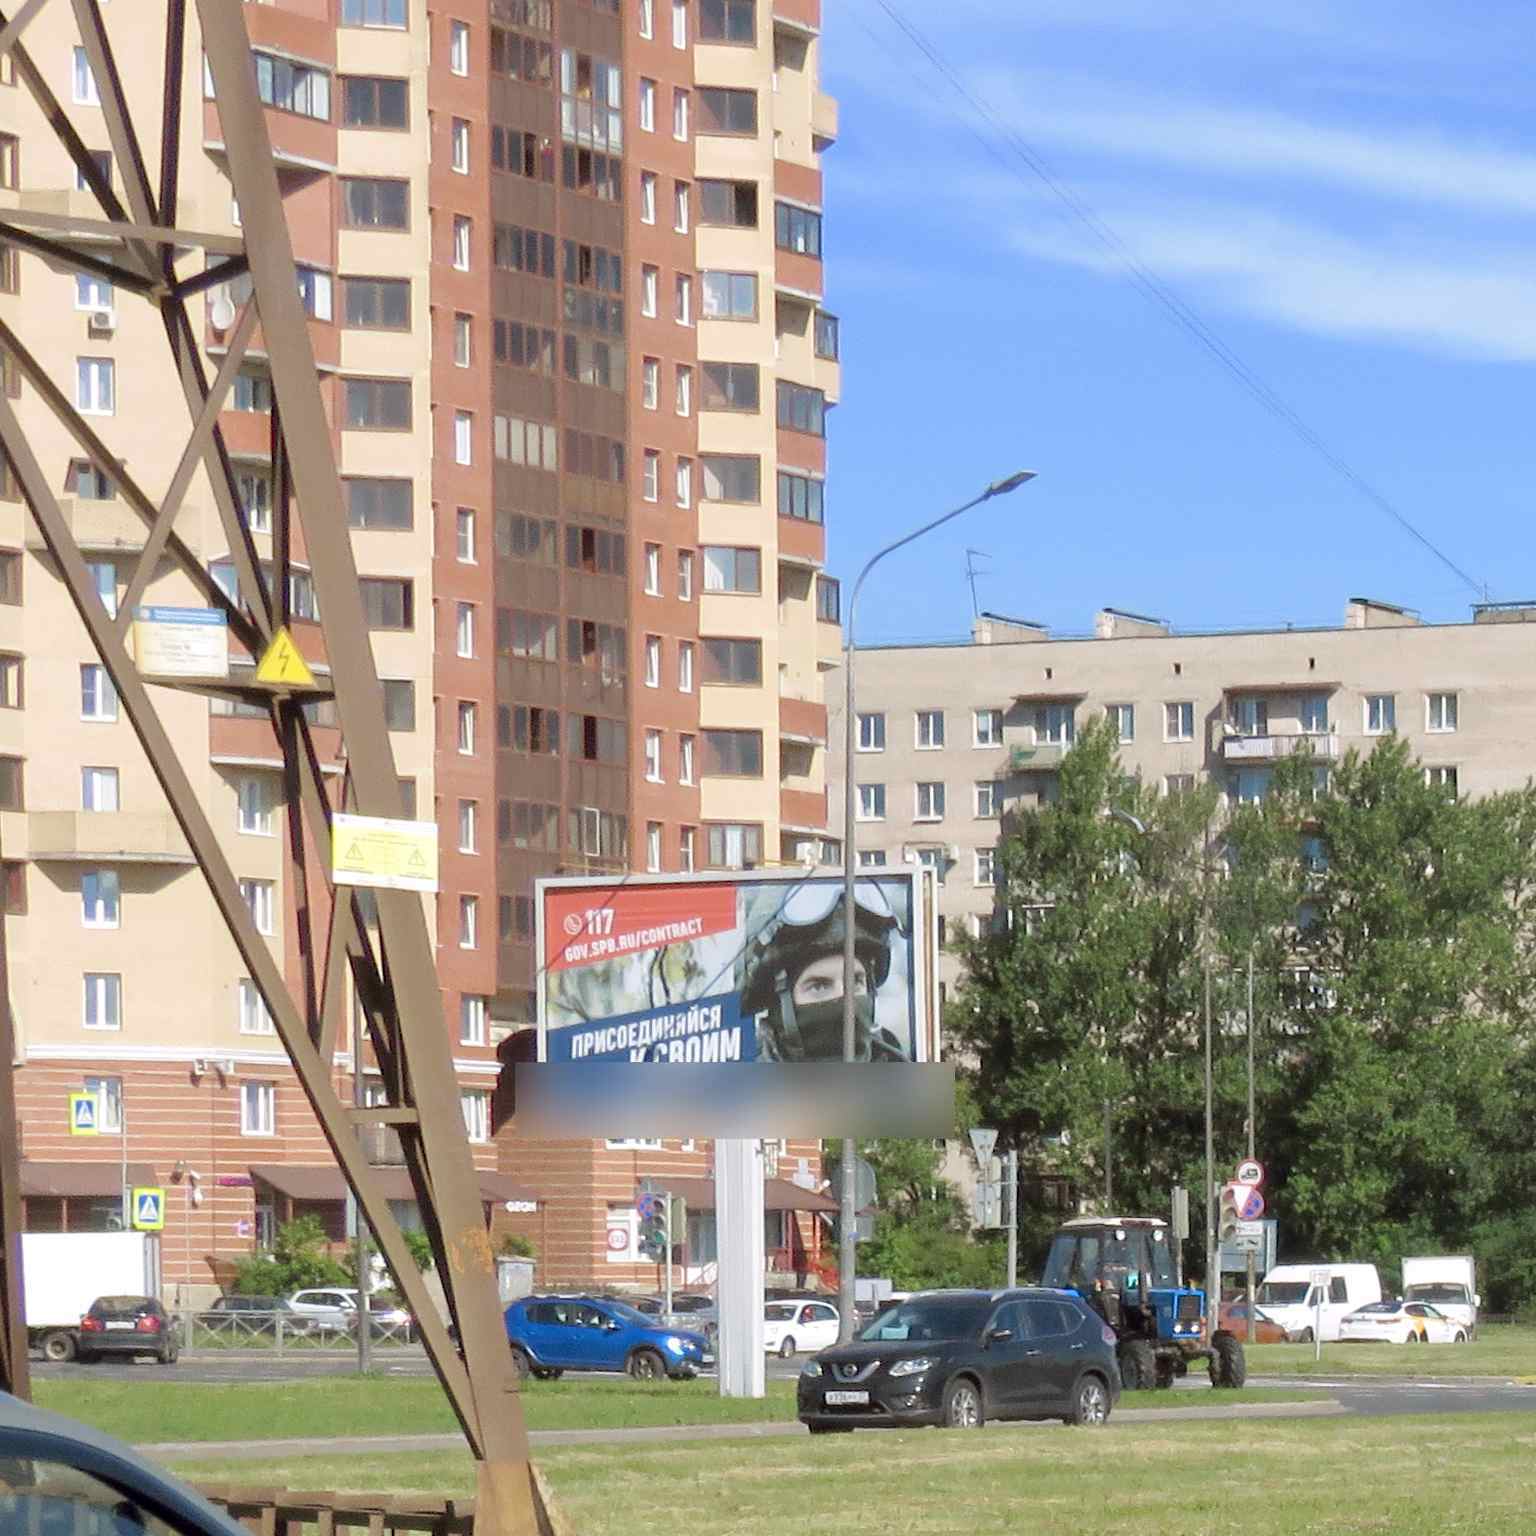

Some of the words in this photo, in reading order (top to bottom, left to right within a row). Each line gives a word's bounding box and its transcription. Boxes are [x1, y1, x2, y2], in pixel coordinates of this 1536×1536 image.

[564, 918, 704, 963] GOV.SPB.RU/CONTRACT
[585, 908, 615, 935] 117
[571, 1003, 722, 1060] ПРИСОЕДИНЯЙСЯ
